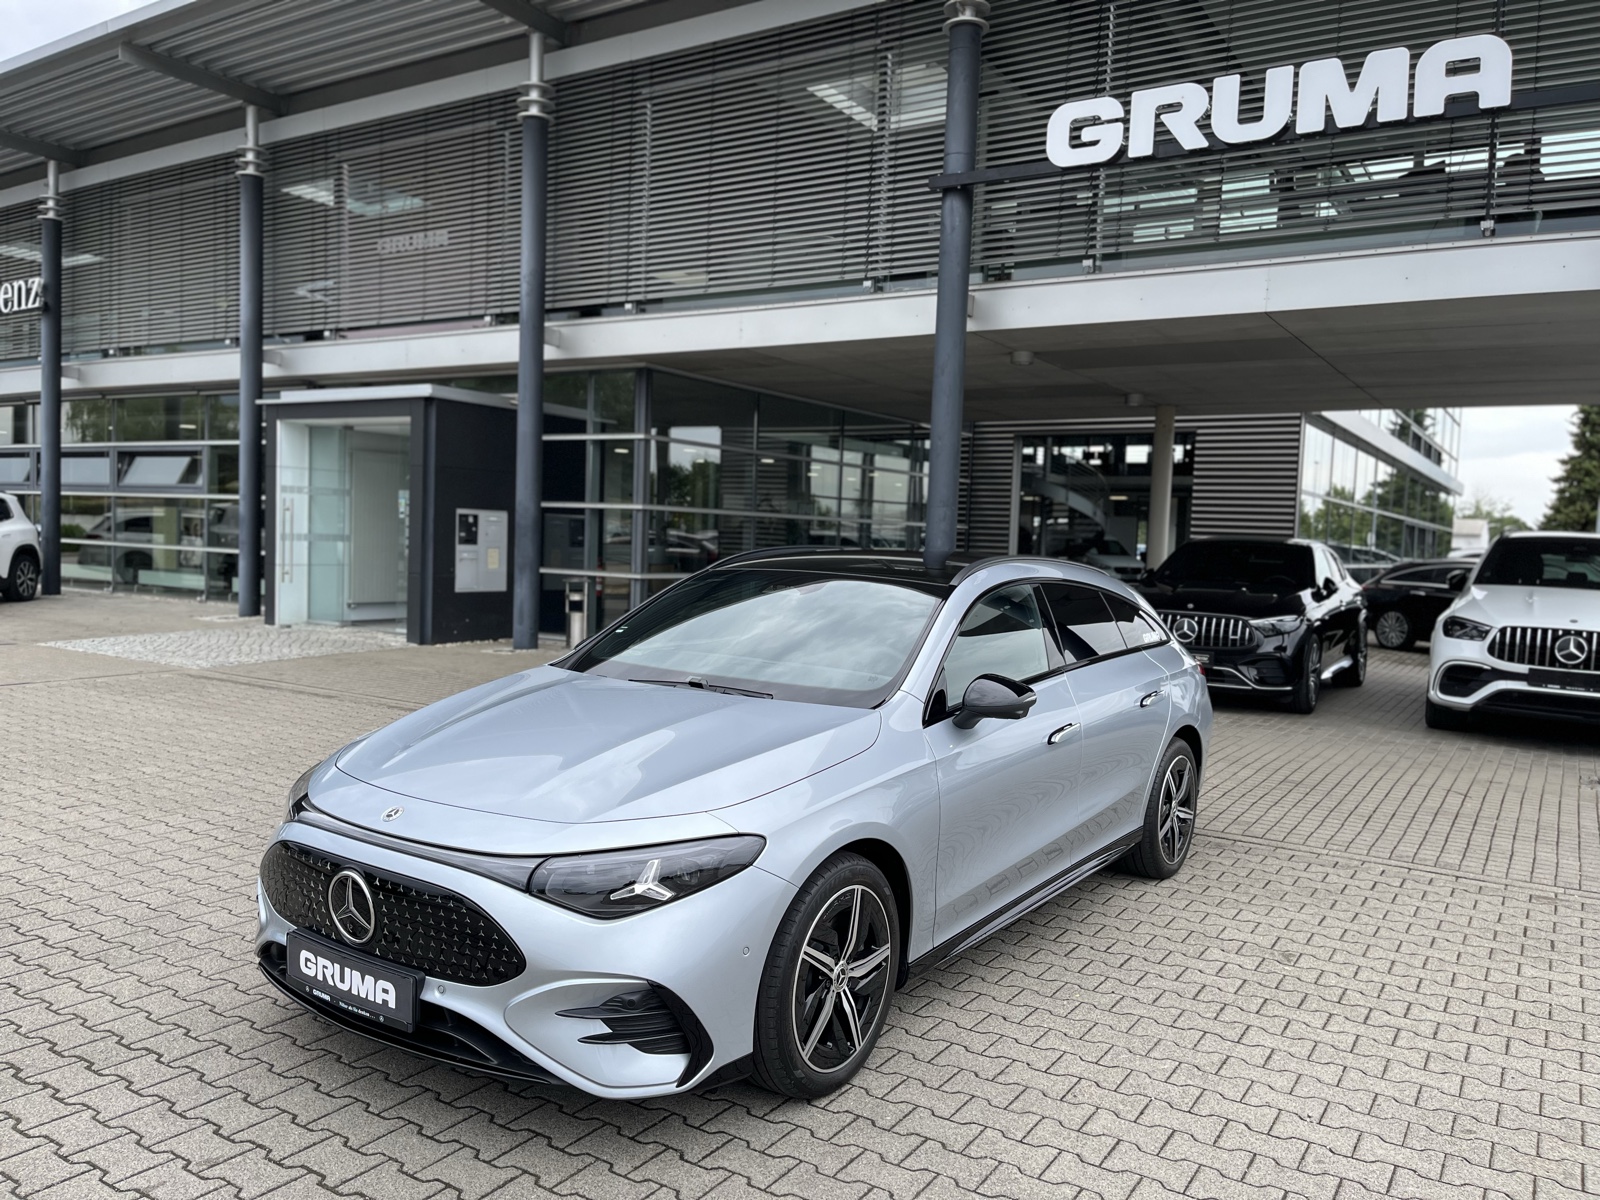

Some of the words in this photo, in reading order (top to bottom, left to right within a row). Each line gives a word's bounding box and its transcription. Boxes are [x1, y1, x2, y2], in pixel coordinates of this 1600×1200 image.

[1046, 34, 1513, 167] GRUMA
[0, 277, 42, 313] enz
[299, 949, 396, 1009] GRUMA
[313, 989, 331, 1002] GRUMA
